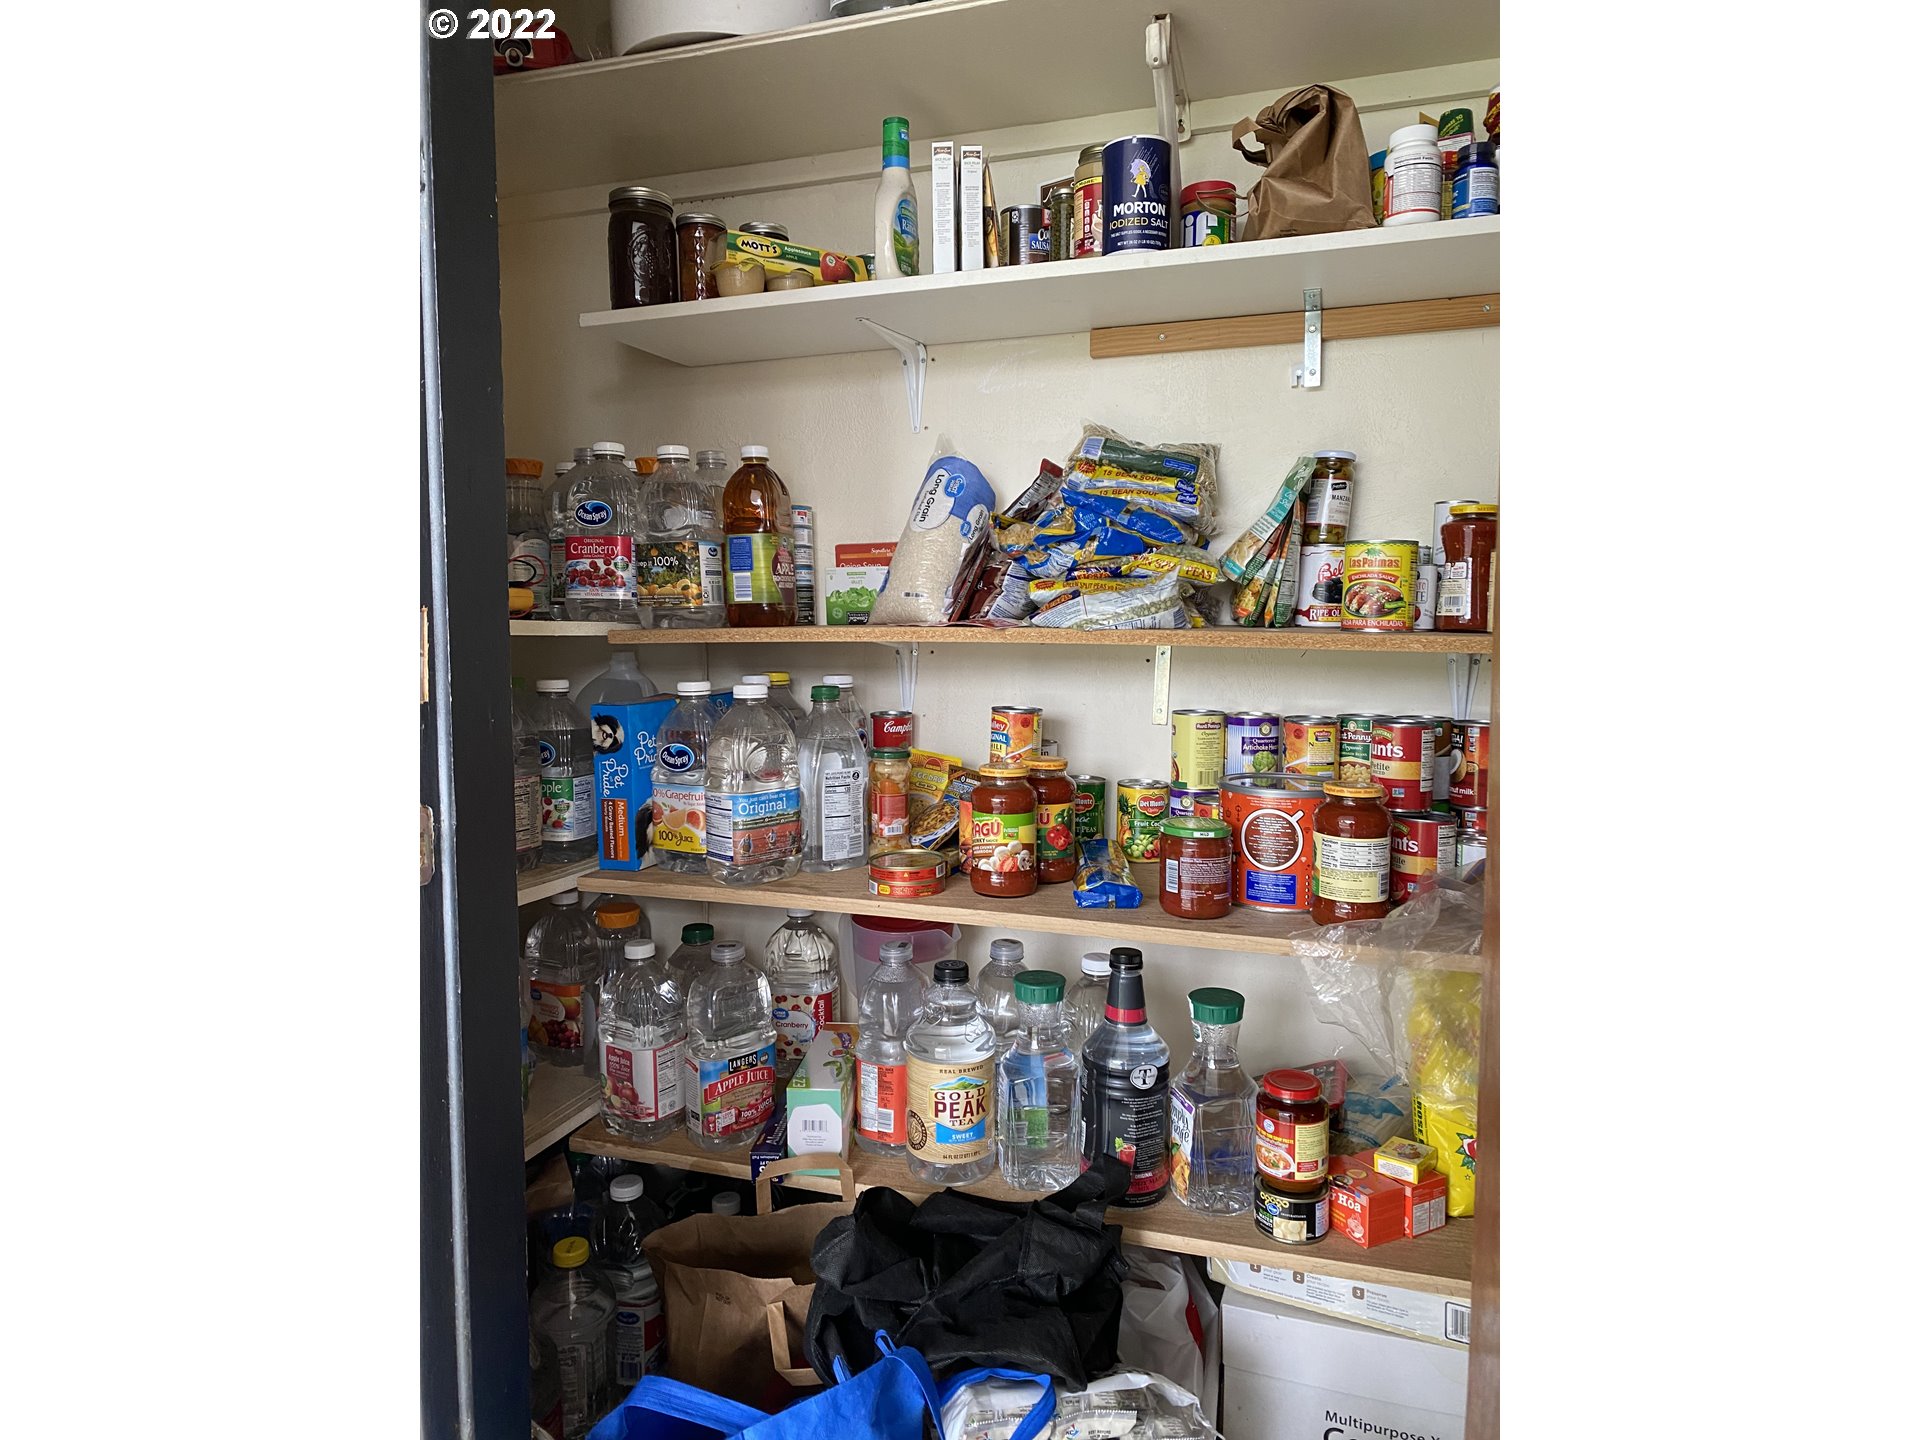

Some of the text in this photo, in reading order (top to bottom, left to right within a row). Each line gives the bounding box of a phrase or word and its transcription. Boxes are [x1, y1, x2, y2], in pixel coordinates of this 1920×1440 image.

[1113, 202, 1166, 217] MORTON
[1109, 217, 1168, 230] IODIZED SALT
[1116, 471, 1138, 480] BEAN
[928, 474, 946, 496] Long
[578, 509, 607, 522] Ocean Spray
[918, 497, 935, 522] Grain
[570, 542, 619, 558] Cranberry
[653, 556, 679, 566] 100%
[1184, 568, 1213, 581] PEAS
[662, 751, 689, 766] Ocean Spray
[602, 758, 617, 798] Pride
[614, 764, 629, 788] Pet
[738, 797, 786, 816] Original
[1082, 825, 1097, 833] PEAS
[729, 1054, 757, 1072] LANGERS
[958, 1064, 984, 1074] BREWED
[714, 1070, 769, 1096] APPLE JUICE
[934, 1086, 986, 1101] GOLD
[934, 1096, 986, 1120] PEAK
[949, 1118, 975, 1127] TEA
[952, 1132, 974, 1140] SWEET
[1325, 1410, 1426, 1440] Multipurpose
